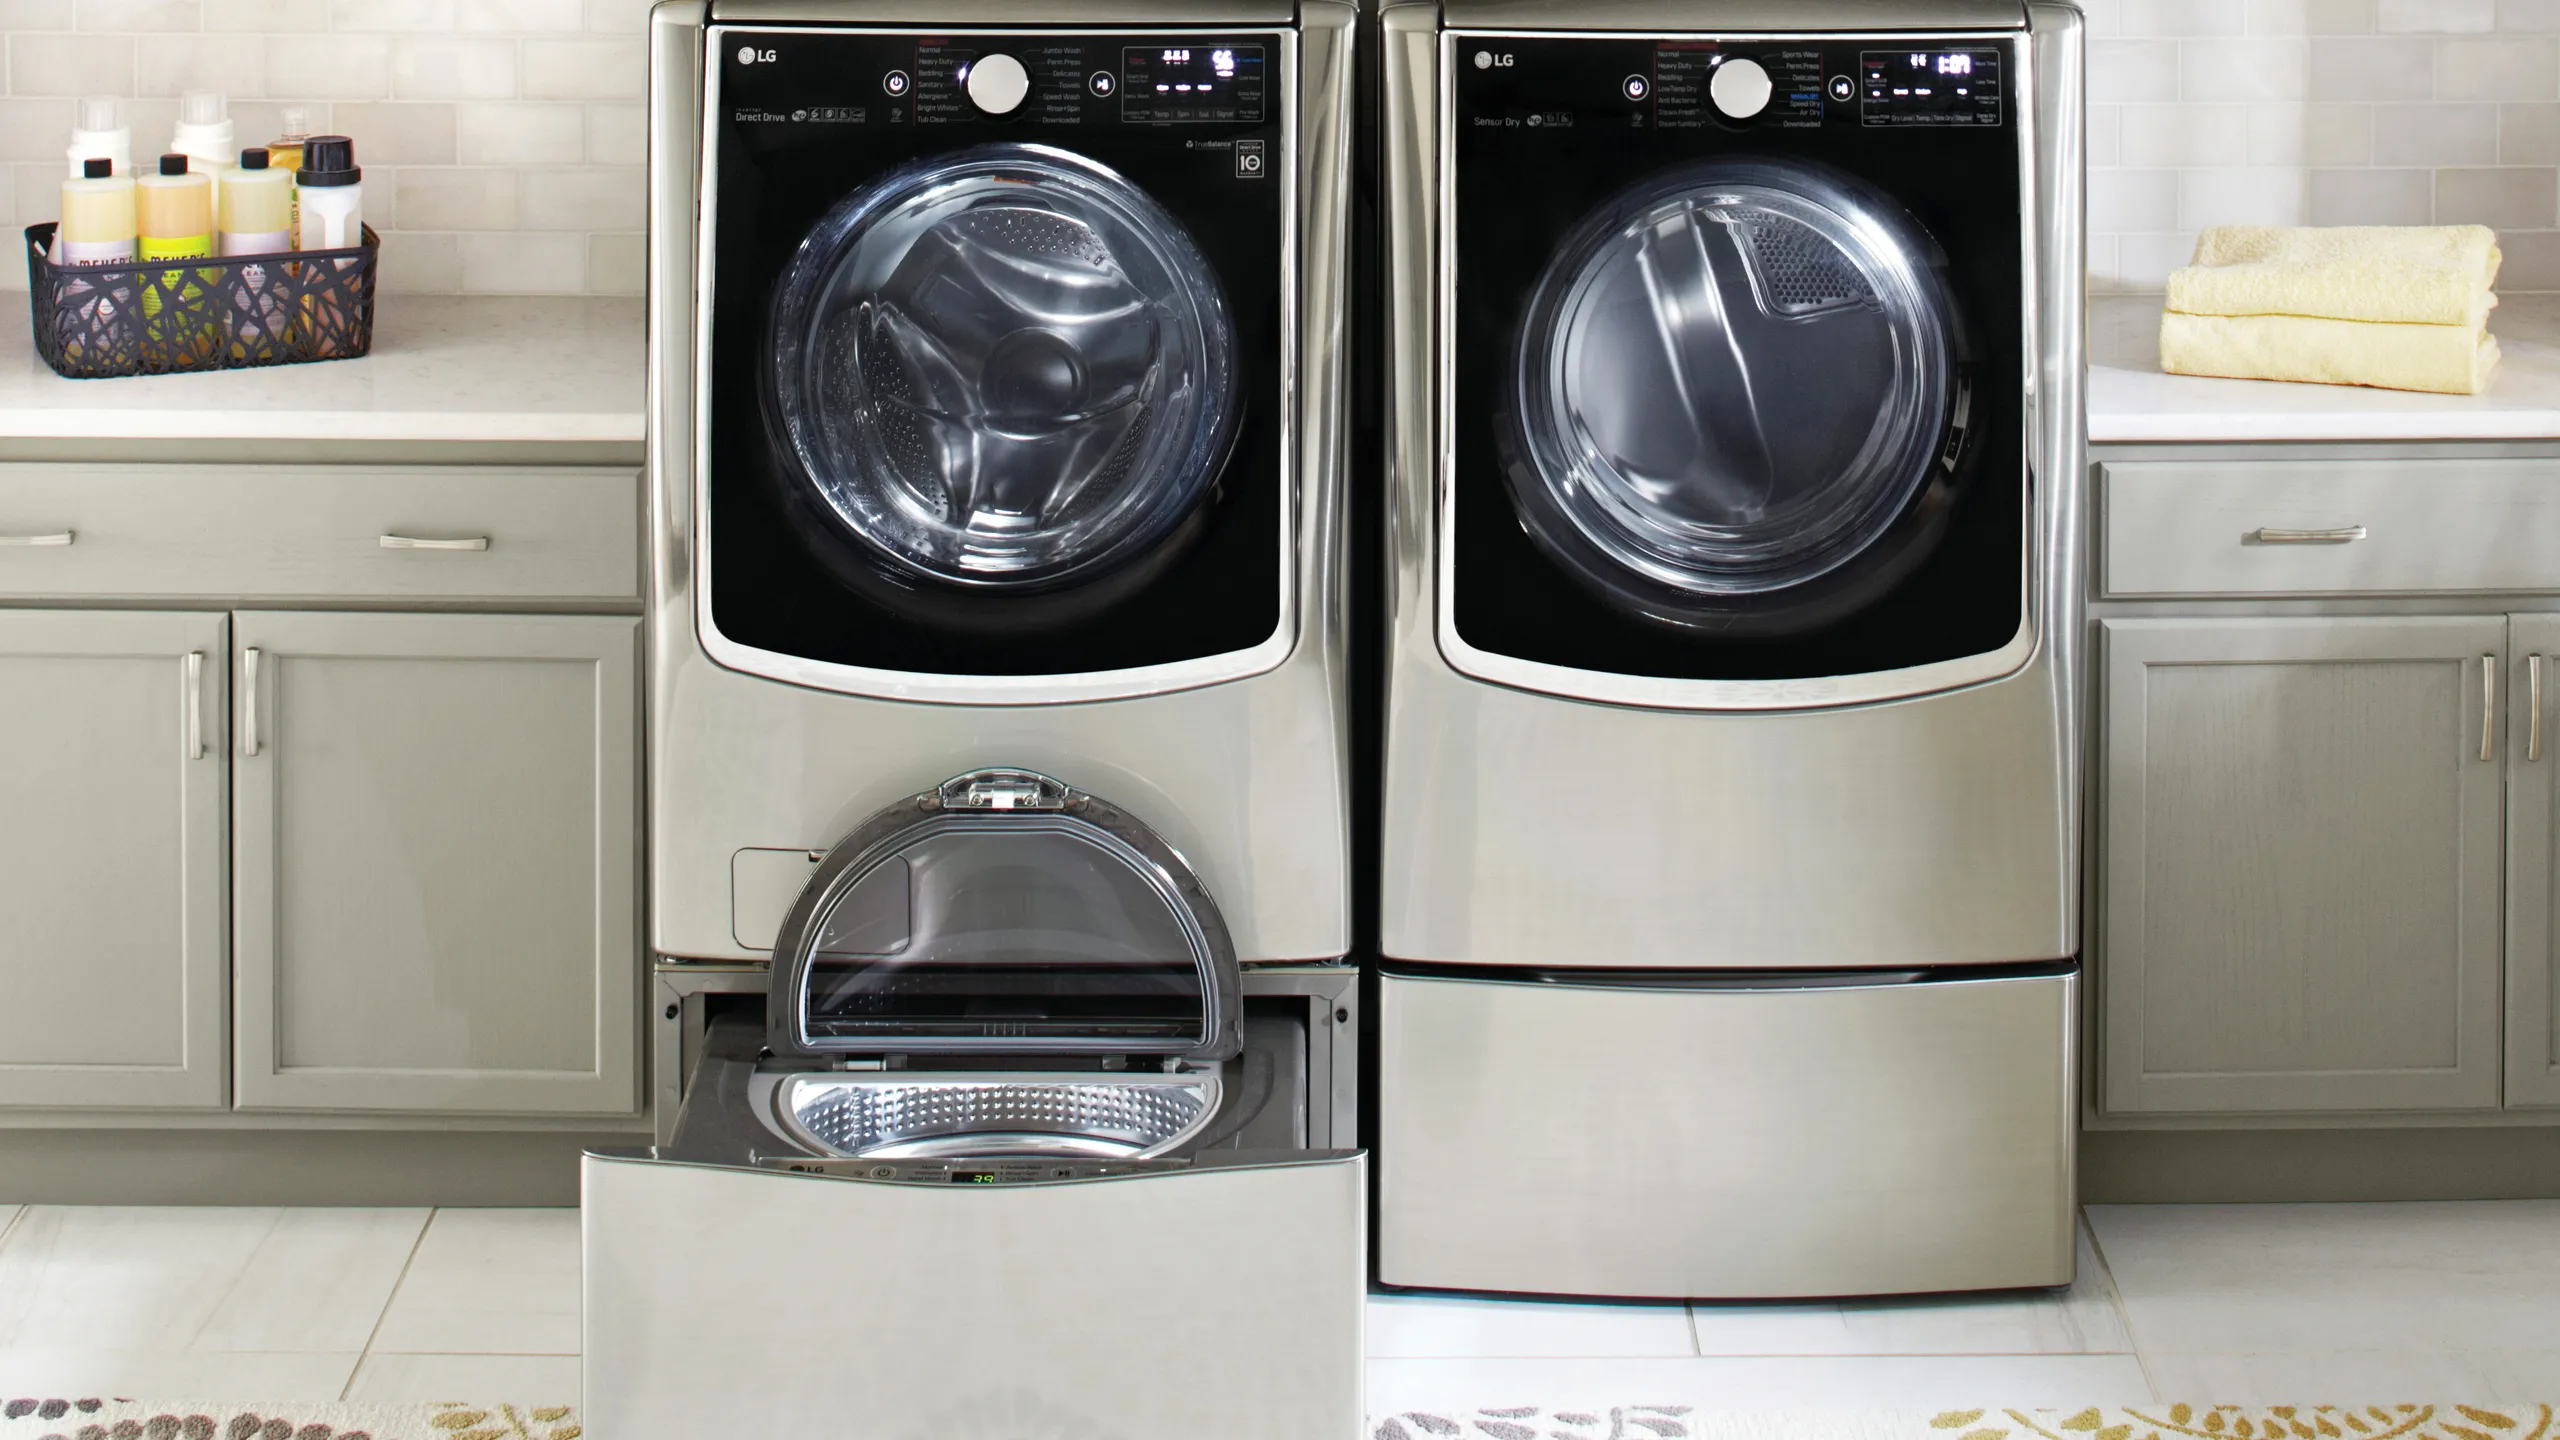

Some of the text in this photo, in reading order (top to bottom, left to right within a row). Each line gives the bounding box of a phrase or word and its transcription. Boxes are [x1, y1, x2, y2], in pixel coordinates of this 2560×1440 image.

[758, 50, 776, 62] LG
[1494, 54, 1514, 67] LG
[918, 58, 954, 66] Heavy Duty
[918, 81, 943, 89] Sanitary
[1043, 93, 1081, 101] Speed Wash
[917, 104, 936, 112] Bright
[735, 113, 785, 122] Direct Drive
[1474, 117, 1520, 128] Sensor Dry
[1240, 155, 1261, 171] 10
